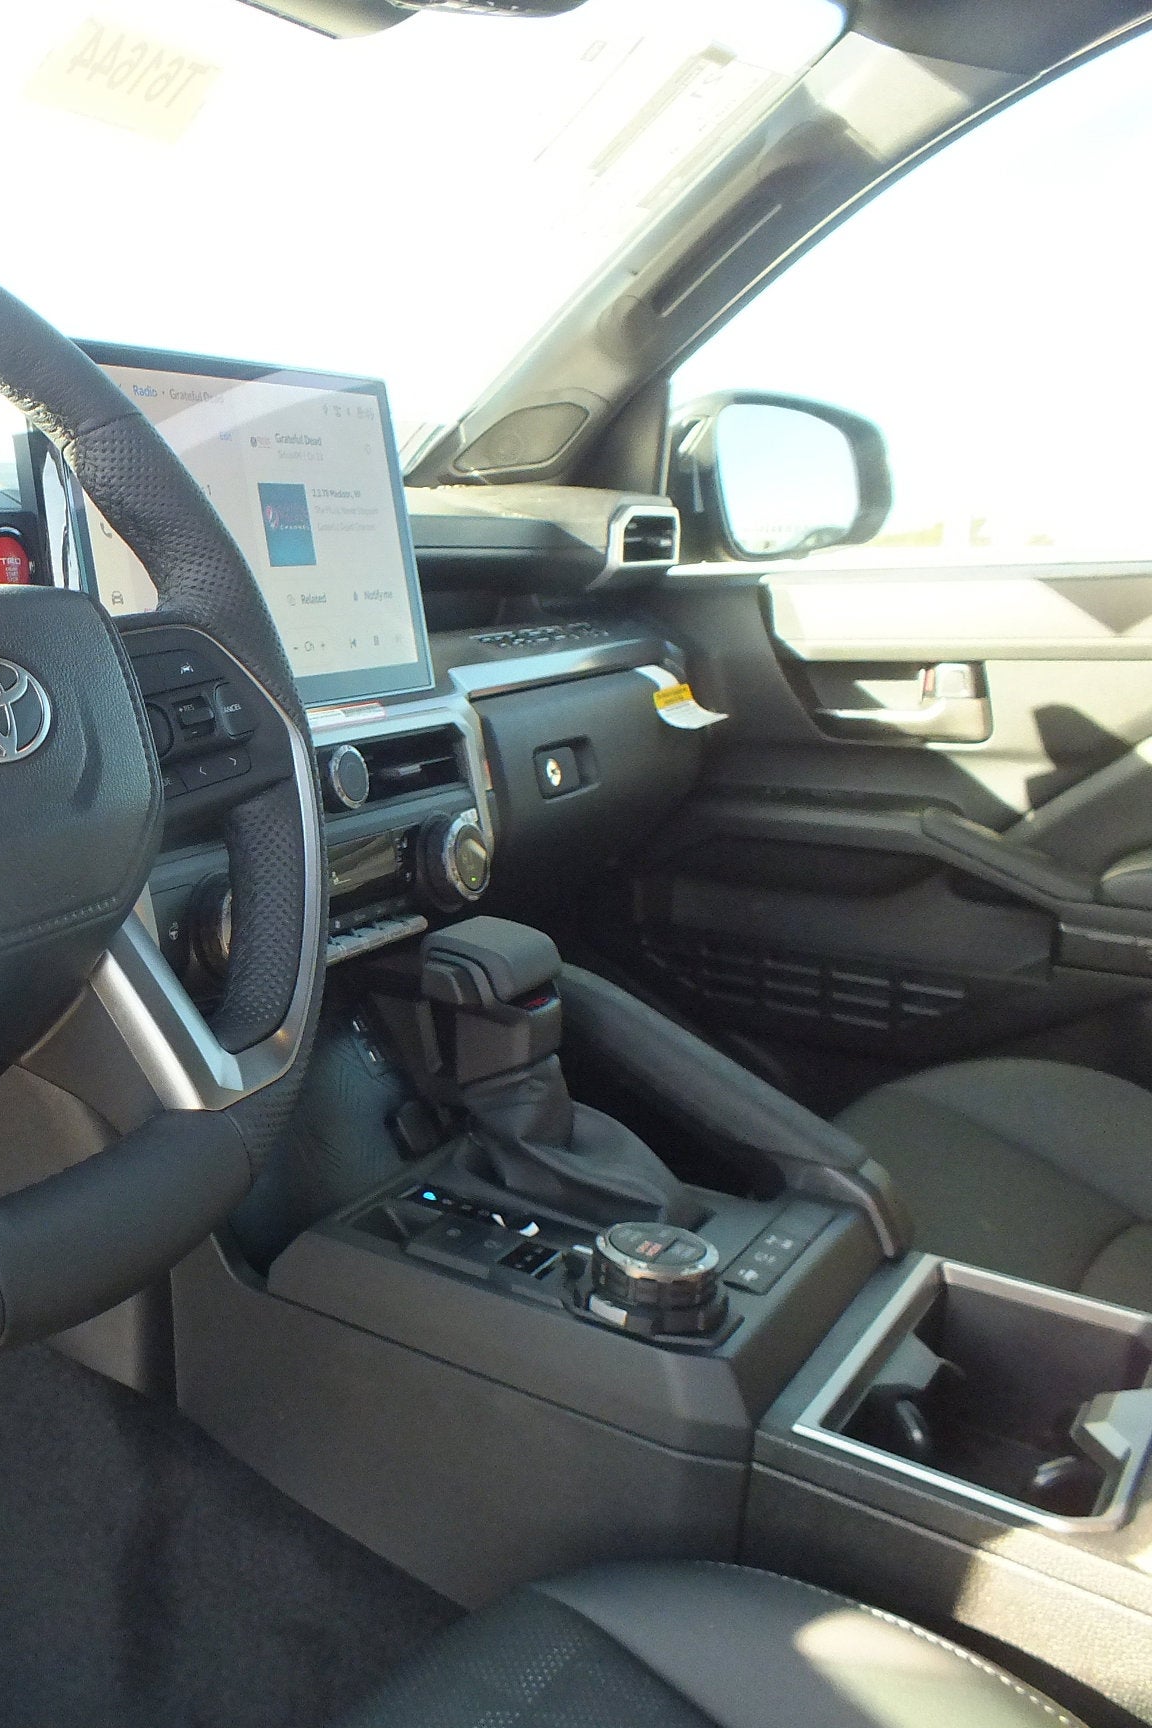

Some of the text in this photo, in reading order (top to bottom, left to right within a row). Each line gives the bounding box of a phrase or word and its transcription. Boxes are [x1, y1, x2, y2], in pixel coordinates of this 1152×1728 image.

[133, 385, 158, 398] Radio
[169, 389, 202, 401] Grateful
[275, 433, 303, 445] Grateful
[304, 435, 322, 446] Dead
